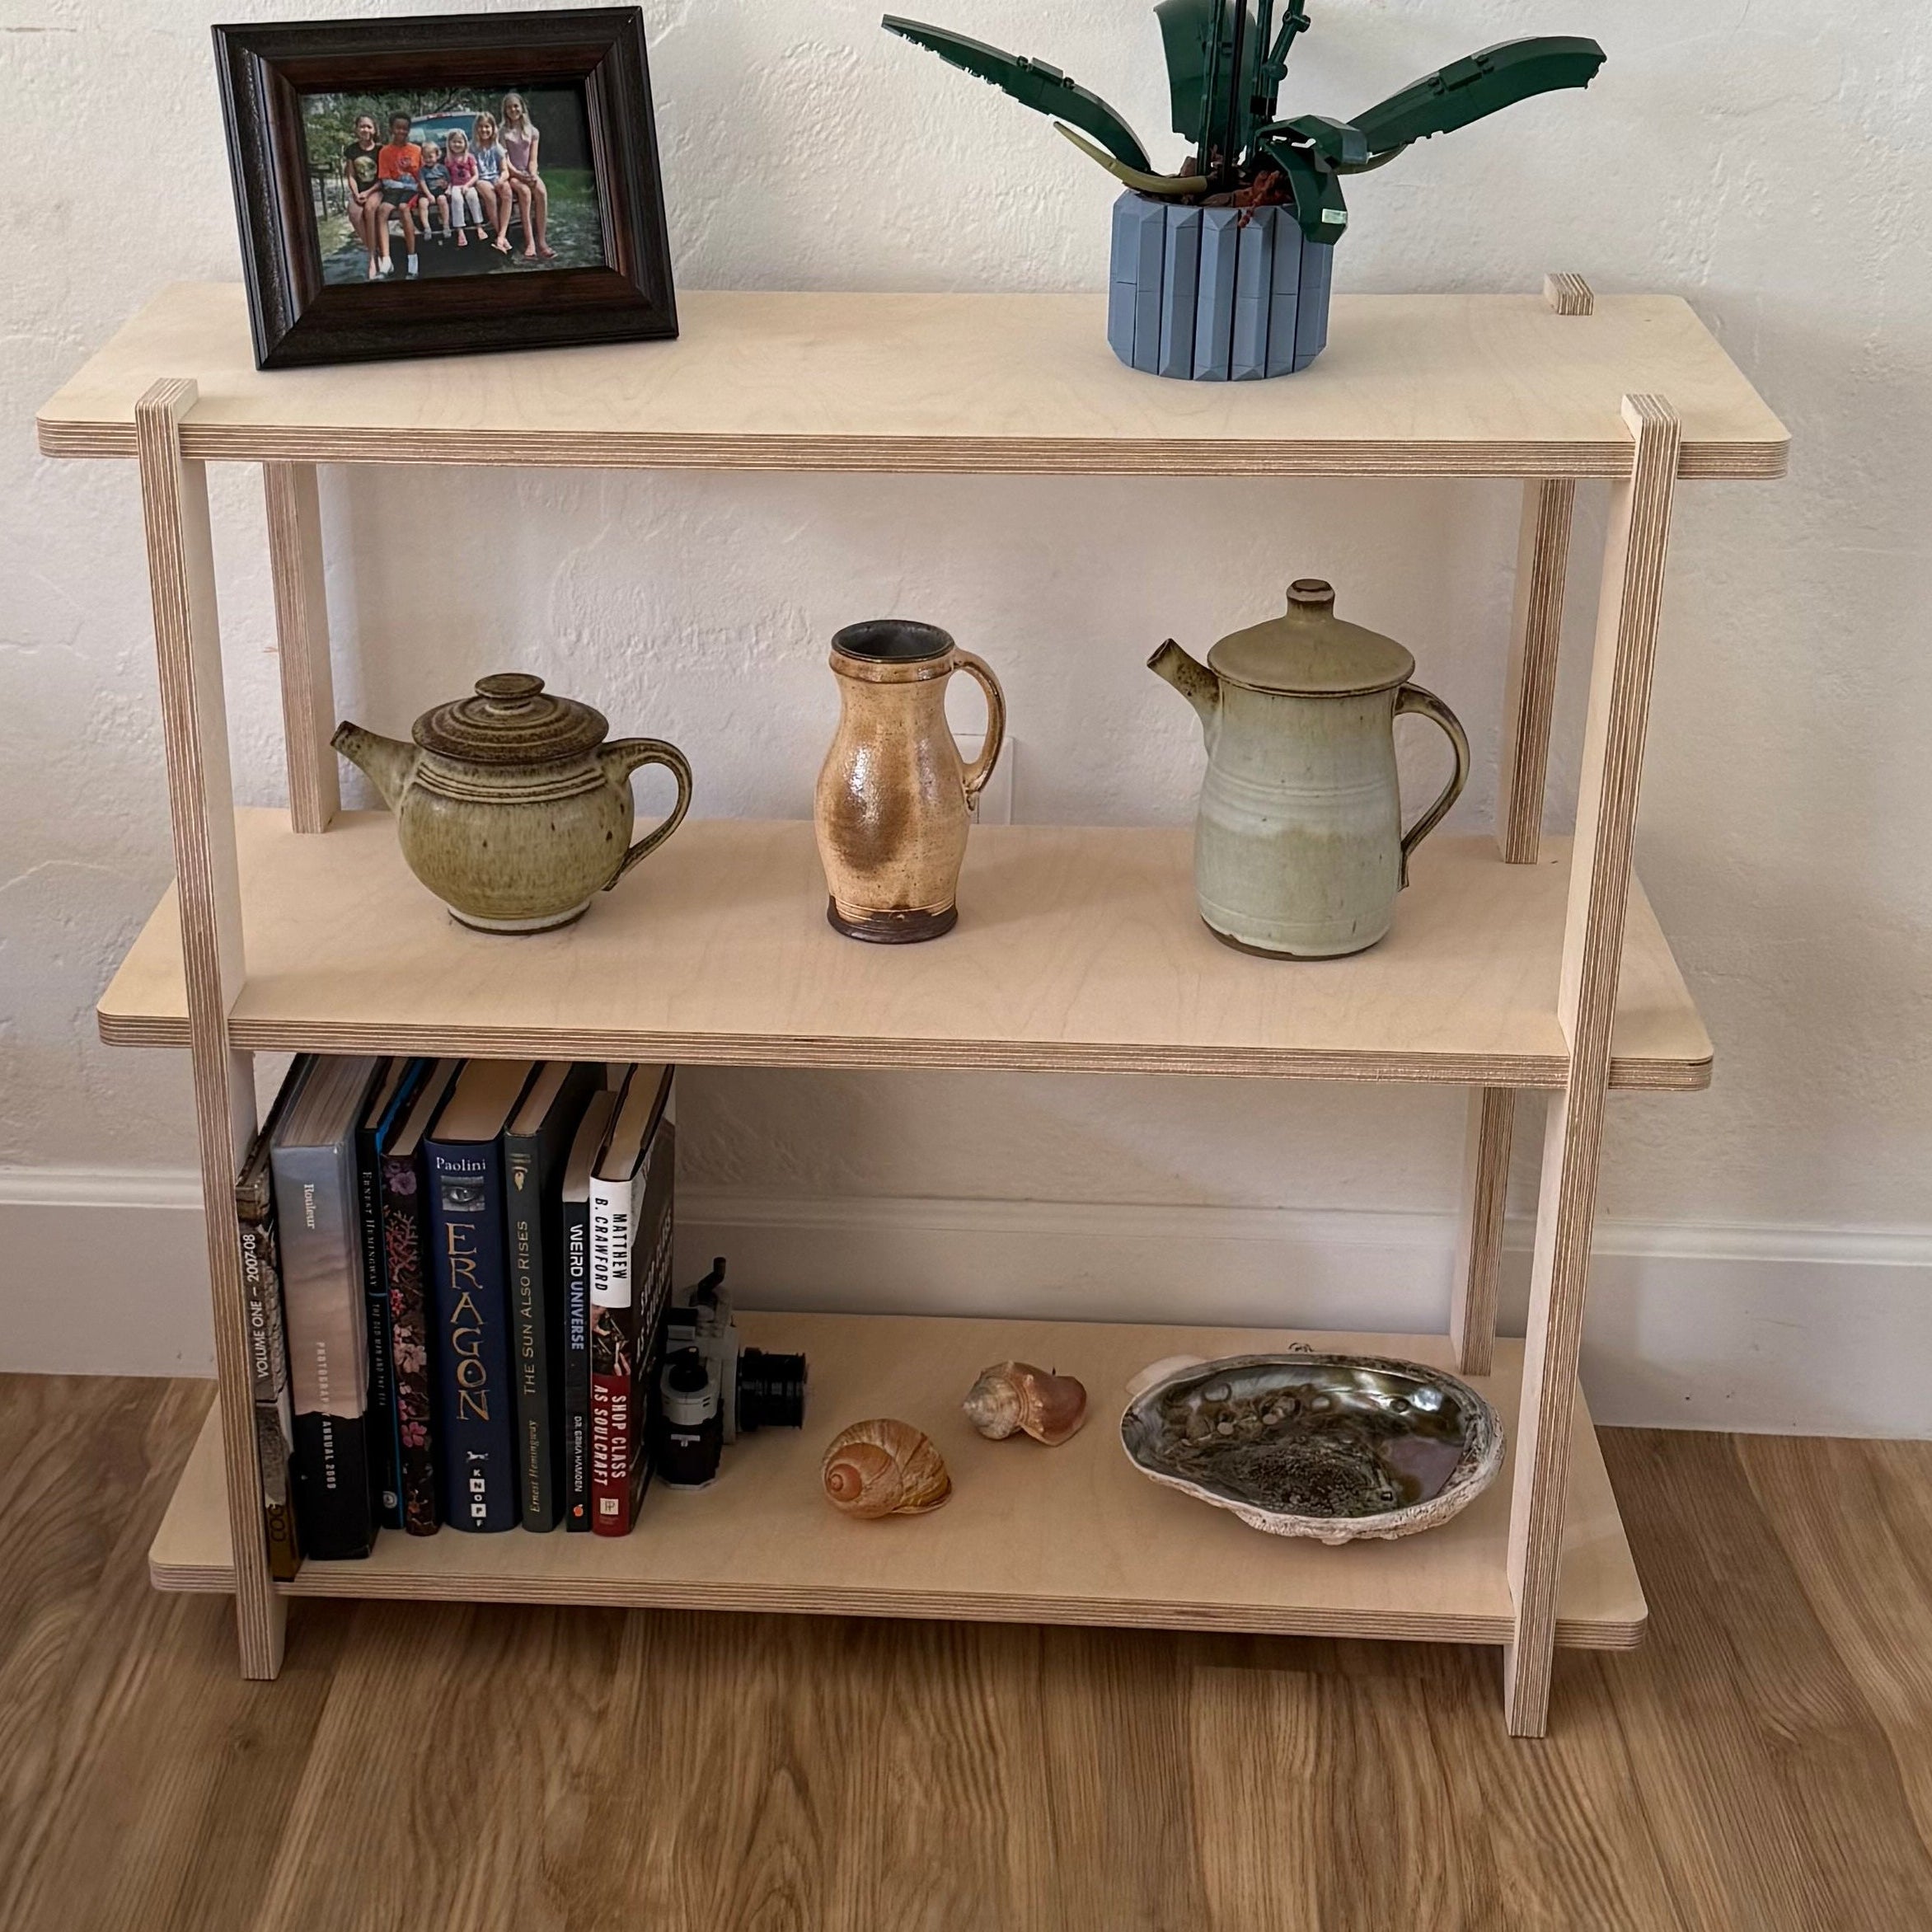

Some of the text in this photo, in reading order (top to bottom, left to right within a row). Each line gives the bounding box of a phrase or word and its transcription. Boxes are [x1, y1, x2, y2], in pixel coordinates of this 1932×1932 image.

[436, 1156, 486, 1171] Paolini
[303, 1184, 317, 1230] Rouleur
[242, 1234, 260, 1283] 2007-08
[365, 1220, 377, 1287] HEMINGWAY
[595, 1198, 608, 1292] B. CRAWFORD
[612, 1213, 627, 1279] MATTHEW
[250, 1301, 264, 1327] ONE
[517, 1221, 536, 1395] THE SUN ALSO RISES
[570, 1224, 584, 1350] WEIRD UNIVERSE
[254, 1330, 270, 1378] VOLUME
[445, 1222, 490, 1421] ERAGON
[321, 1421, 334, 1461] ANNUAL
[528, 1419, 541, 1512] Ernest Hemingway
[593, 1385, 608, 1486] AS SOULCRAFT
[612, 1395, 626, 1479] SHOP CLASS
